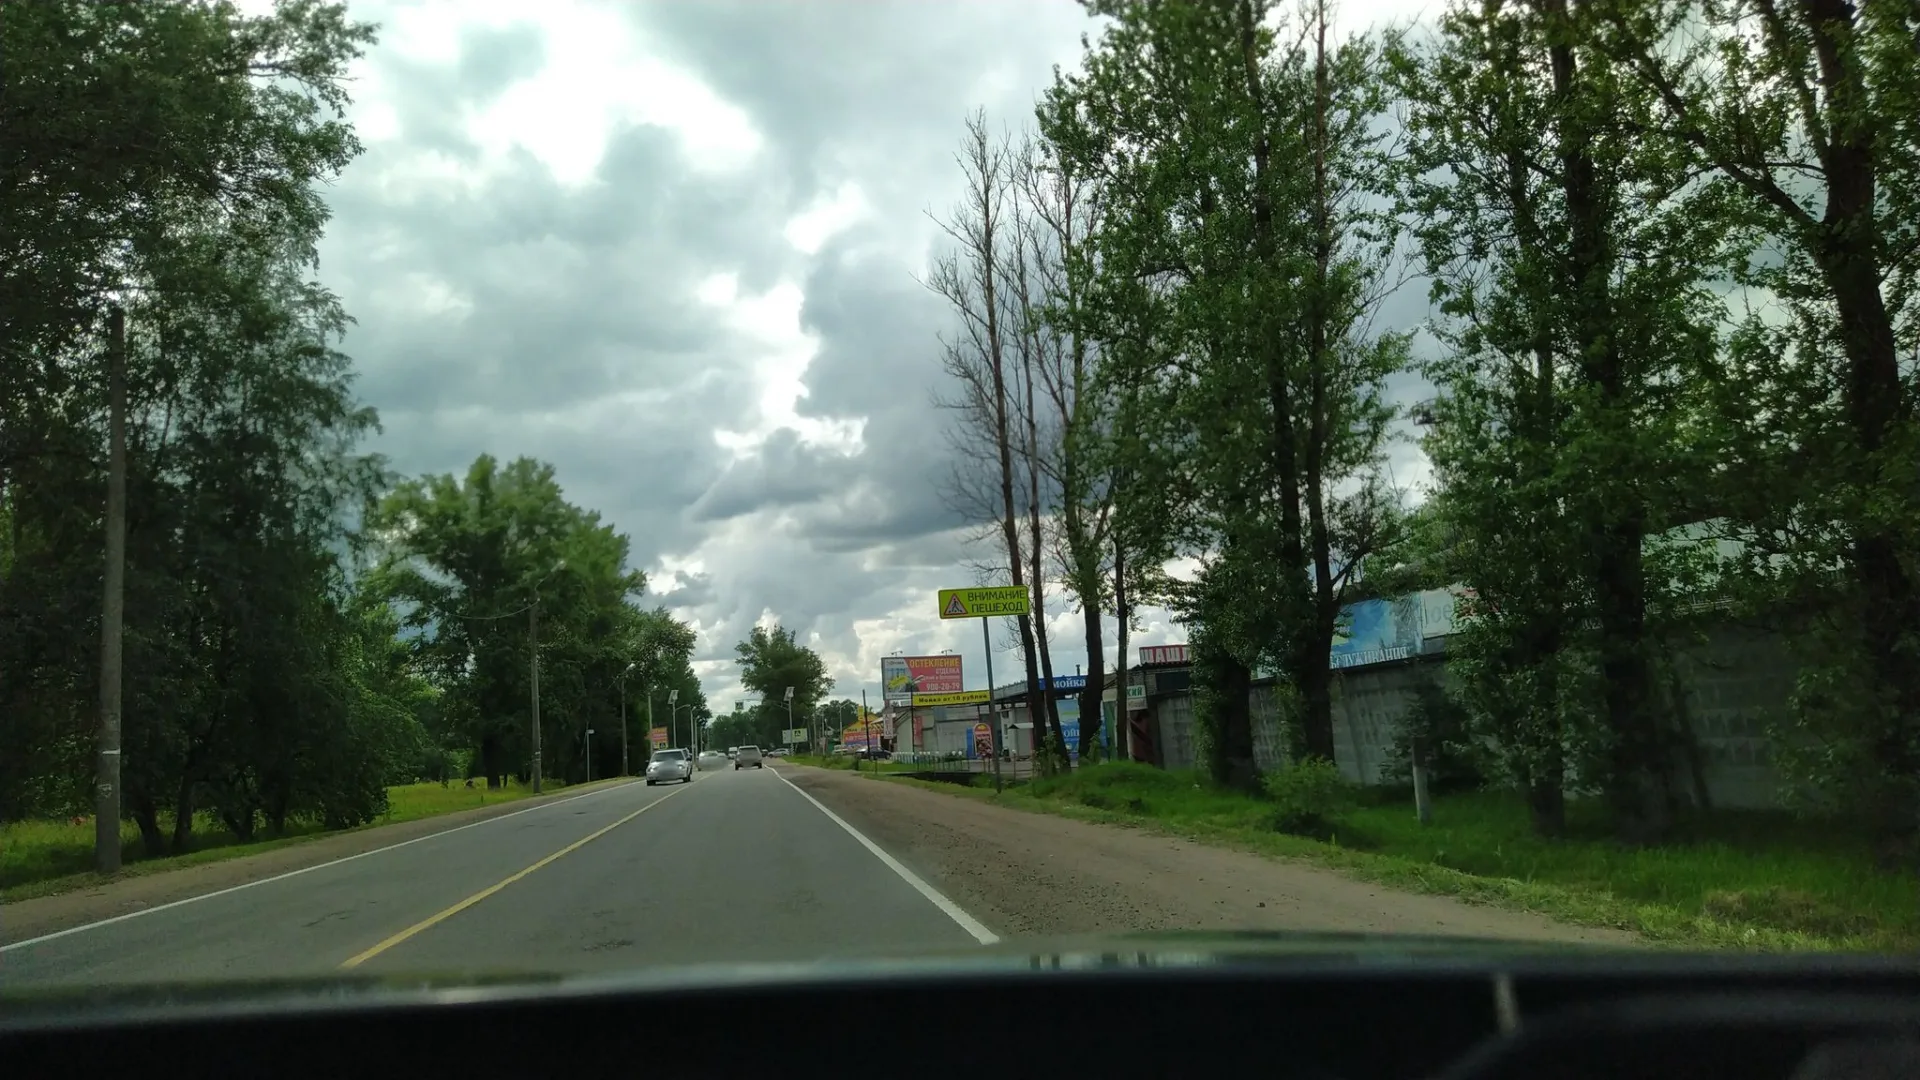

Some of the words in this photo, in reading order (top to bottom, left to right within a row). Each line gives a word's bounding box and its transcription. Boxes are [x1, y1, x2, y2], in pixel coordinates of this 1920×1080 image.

[967, 589, 1025, 602] ВНИМАНИЕ
[971, 601, 1024, 613] ПЕШЕХОД
[910, 658, 960, 668] ОСТЕКЛЕНИЕ
